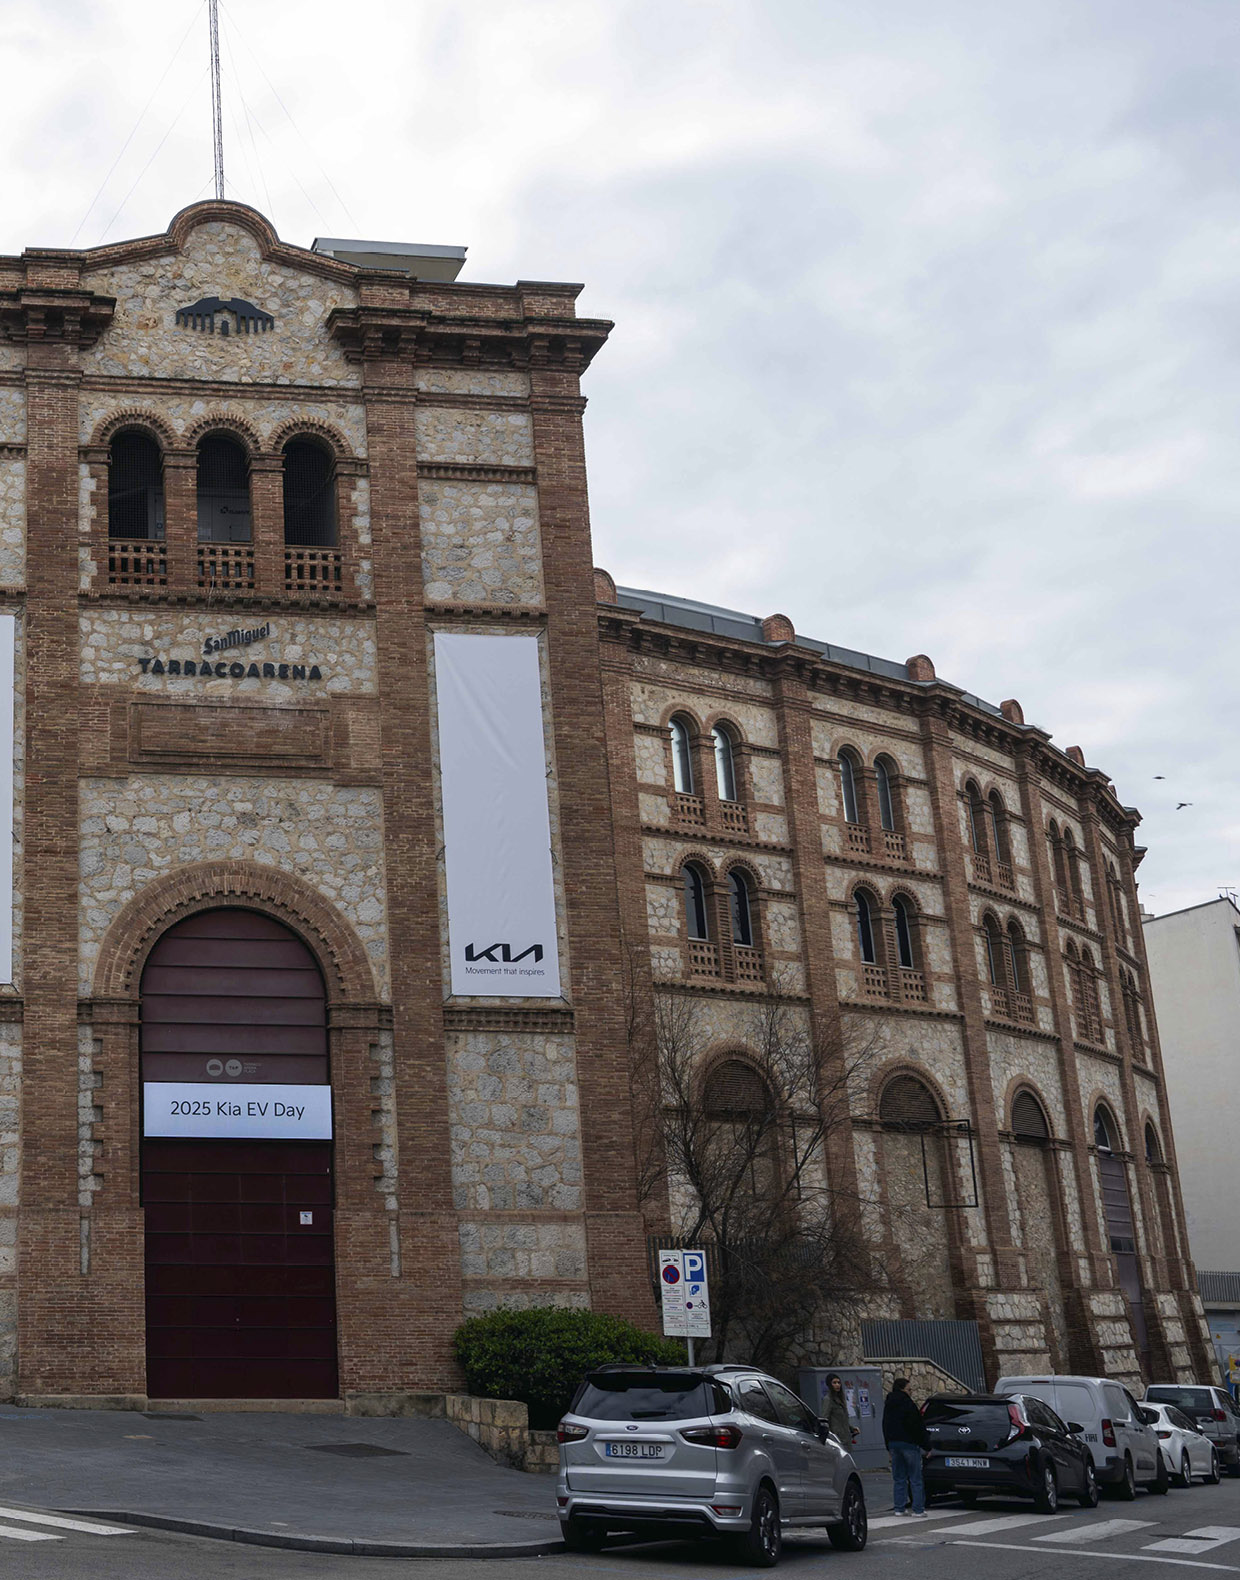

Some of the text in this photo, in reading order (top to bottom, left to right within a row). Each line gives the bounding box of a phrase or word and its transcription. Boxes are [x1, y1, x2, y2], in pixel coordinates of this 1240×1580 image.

[138, 657, 323, 681] TARRACOARENA
[464, 943, 544, 964] KIA
[465, 966, 546, 977] Movement that inspires
[170, 1100, 306, 1121] 2025 Kia EV Day
[684, 1255, 703, 1280] P
[611, 1444, 663, 1457] 6198 LDP
[950, 1459, 970, 1467] 3541
